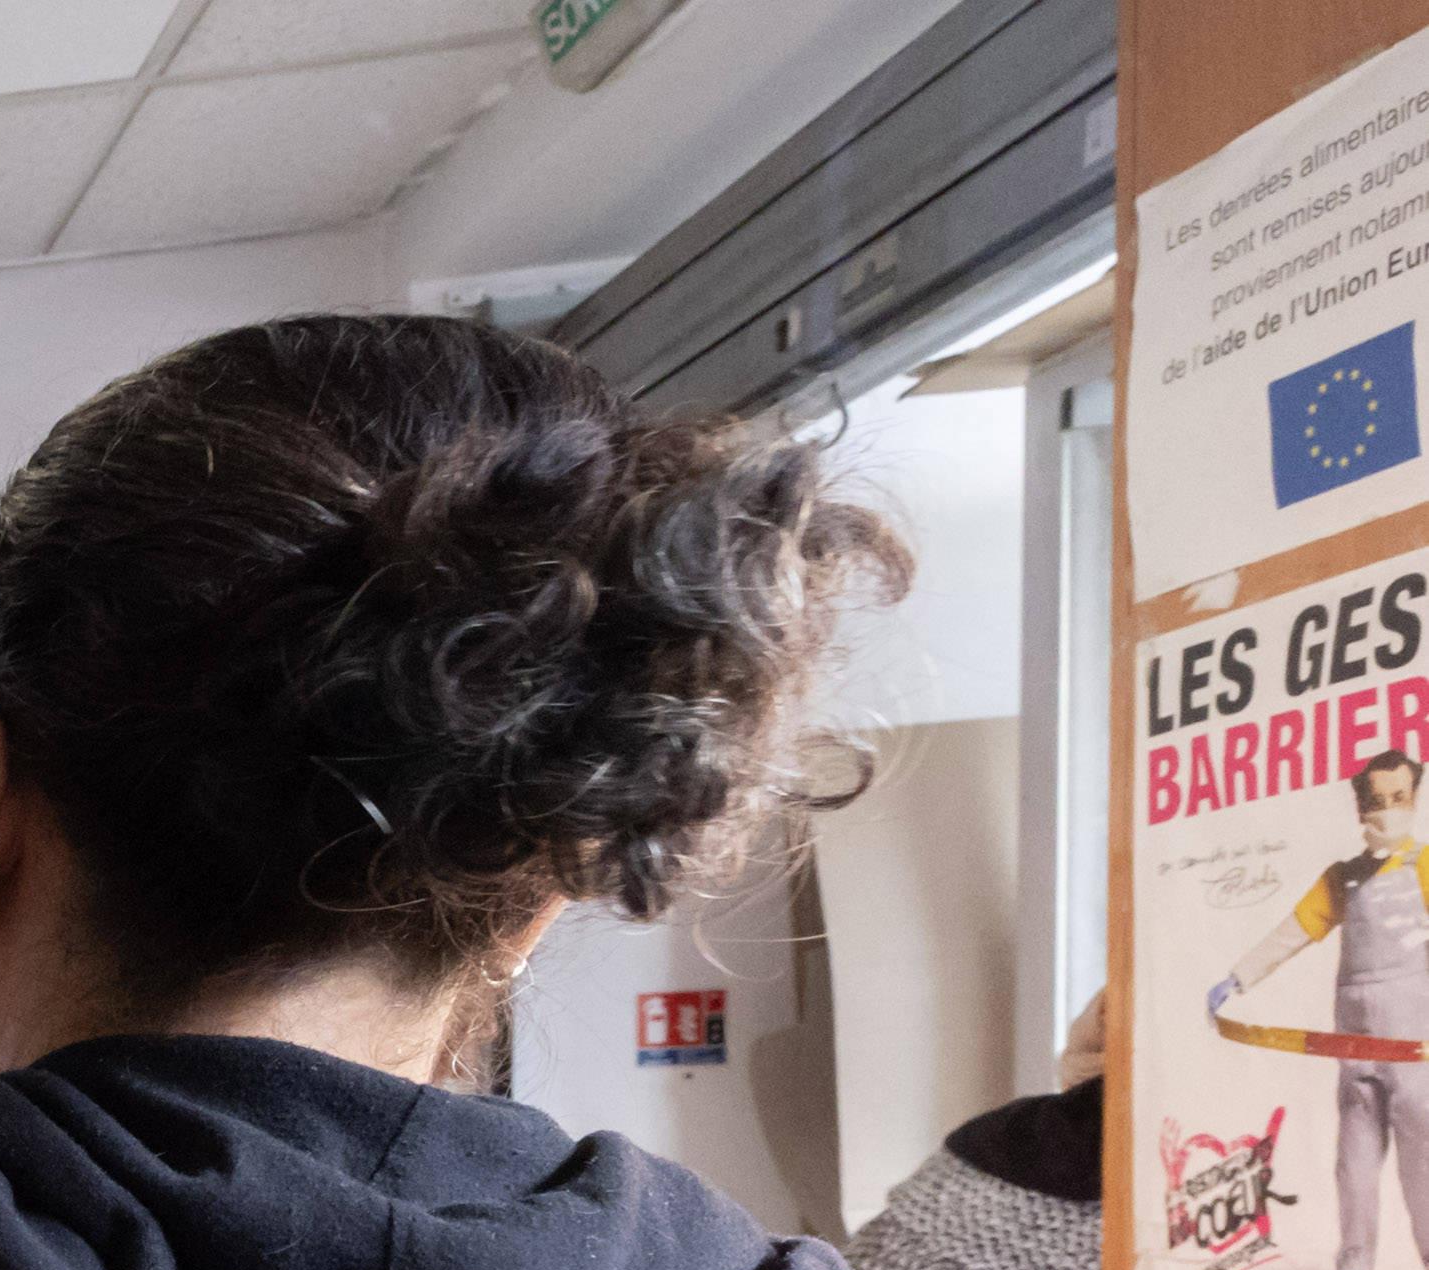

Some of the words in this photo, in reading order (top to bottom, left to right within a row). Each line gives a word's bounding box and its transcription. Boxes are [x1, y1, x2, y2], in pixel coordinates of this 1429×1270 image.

[1166, 218, 1202, 251] Les
[1209, 167, 1293, 228] denrées
[1300, 90, 1429, 178] alimentaire
[1212, 231, 1255, 271] sont
[1262, 182, 1353, 244] remises
[1163, 360, 1186, 385] de
[1192, 329, 1247, 372] l'aide
[1255, 313, 1282, 341] de
[1290, 266, 1378, 324] l'Union
[1213, 232, 1342, 322] proviennent
[1147, 627, 1258, 738] LES
[1285, 572, 1429, 697] GES
[1147, 675, 1429, 826] BARRIER
